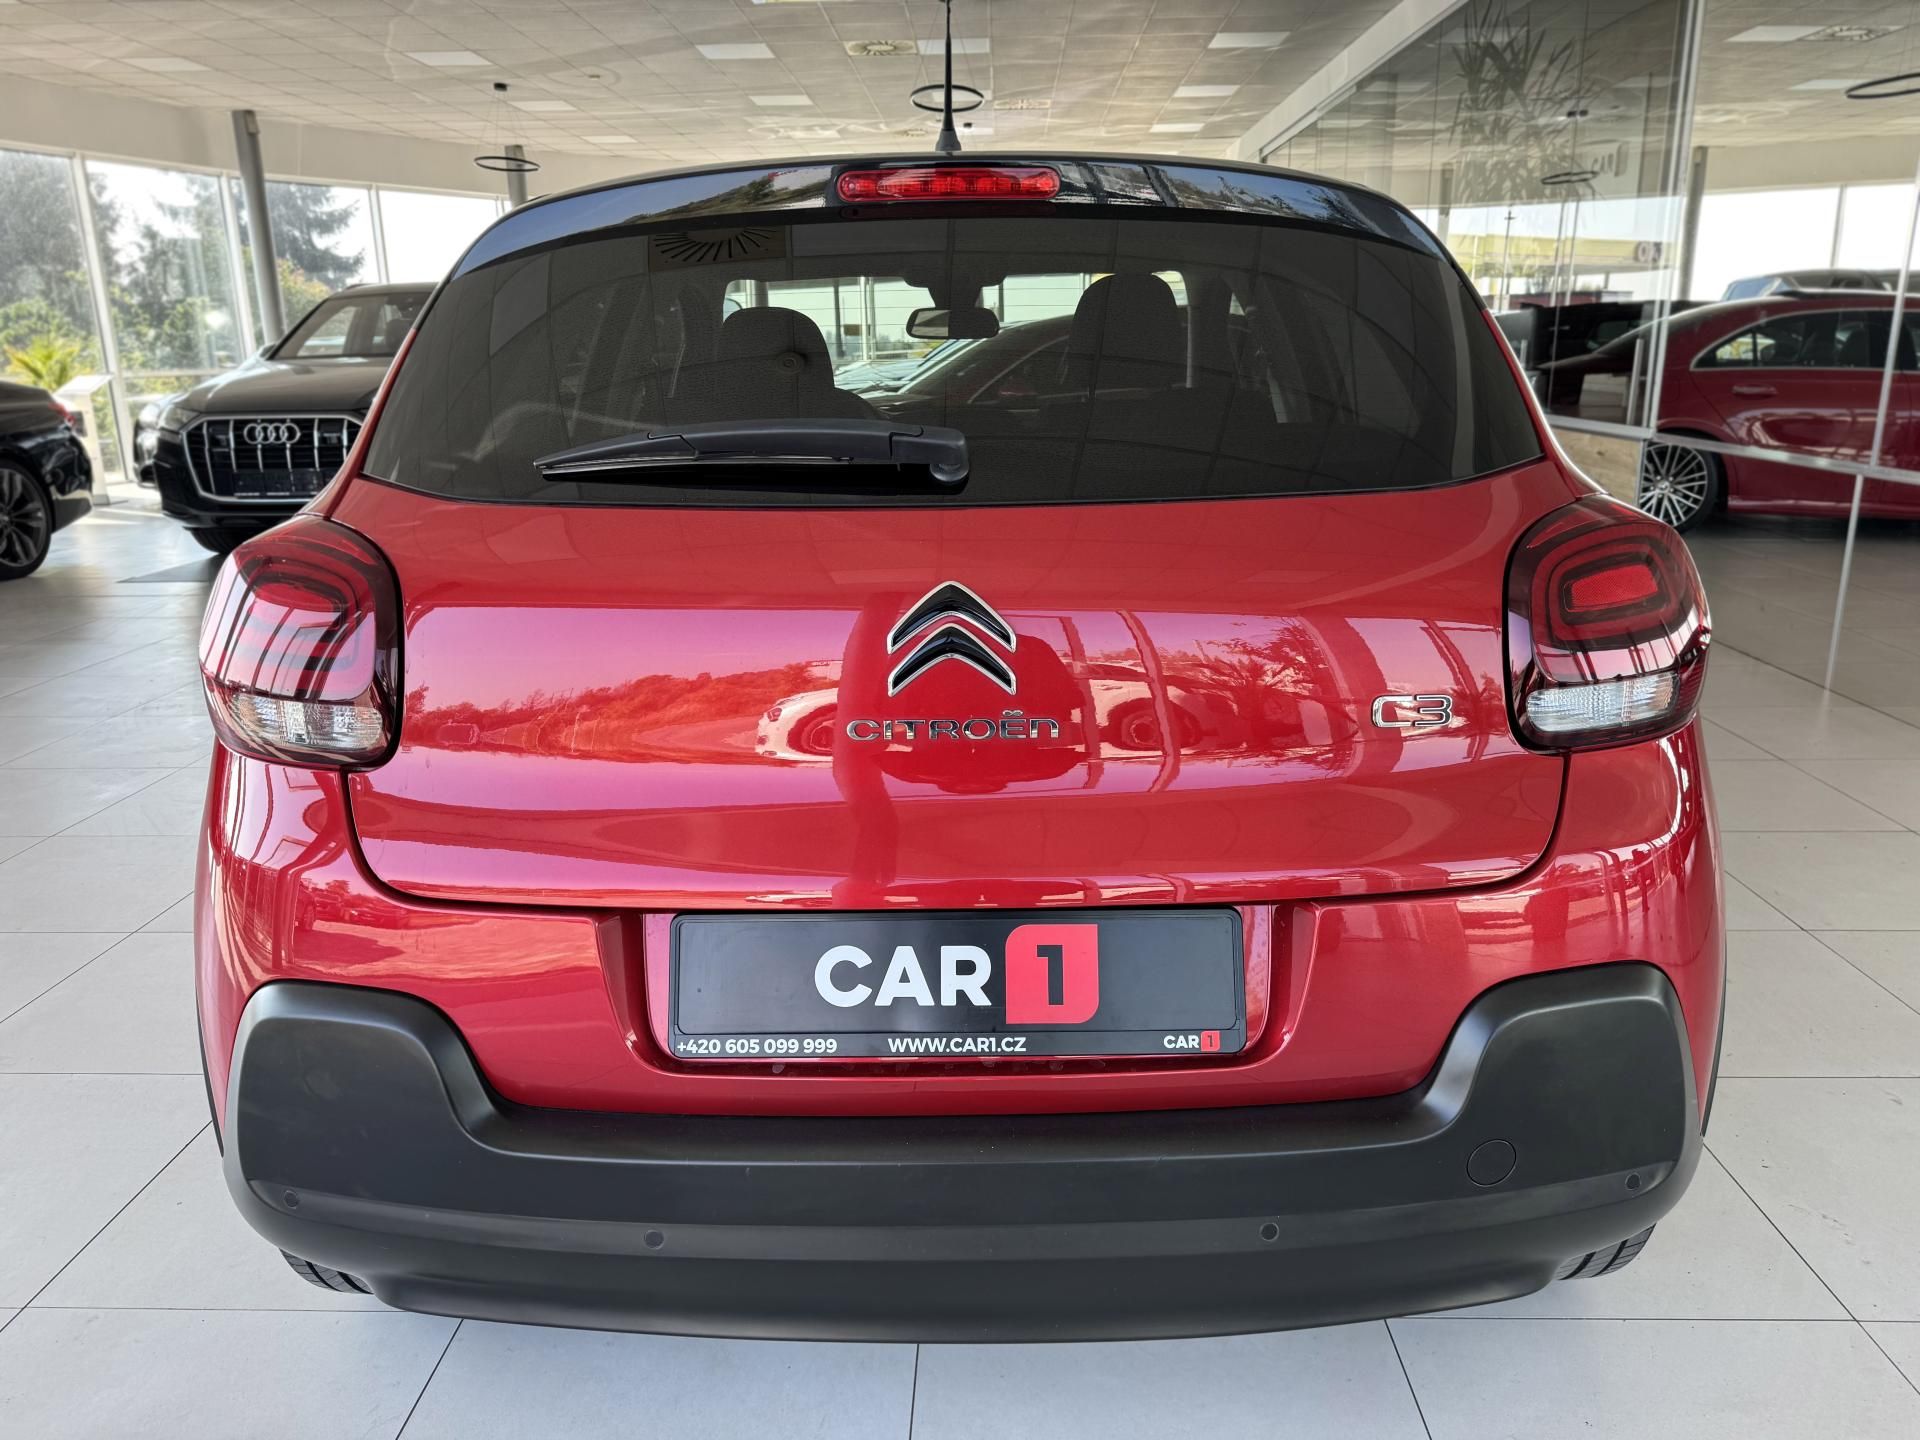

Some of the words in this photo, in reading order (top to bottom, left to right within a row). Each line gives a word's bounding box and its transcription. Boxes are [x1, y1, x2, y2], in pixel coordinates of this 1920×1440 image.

[1371, 694, 1453, 728] C3
[677, 1038, 721, 1054] +420
[725, 1038, 760, 1054] 605
[763, 1038, 799, 1054] 099
[803, 1038, 838, 1054] 999
[887, 1036, 1027, 1053] WWW.CAR1.CZ
